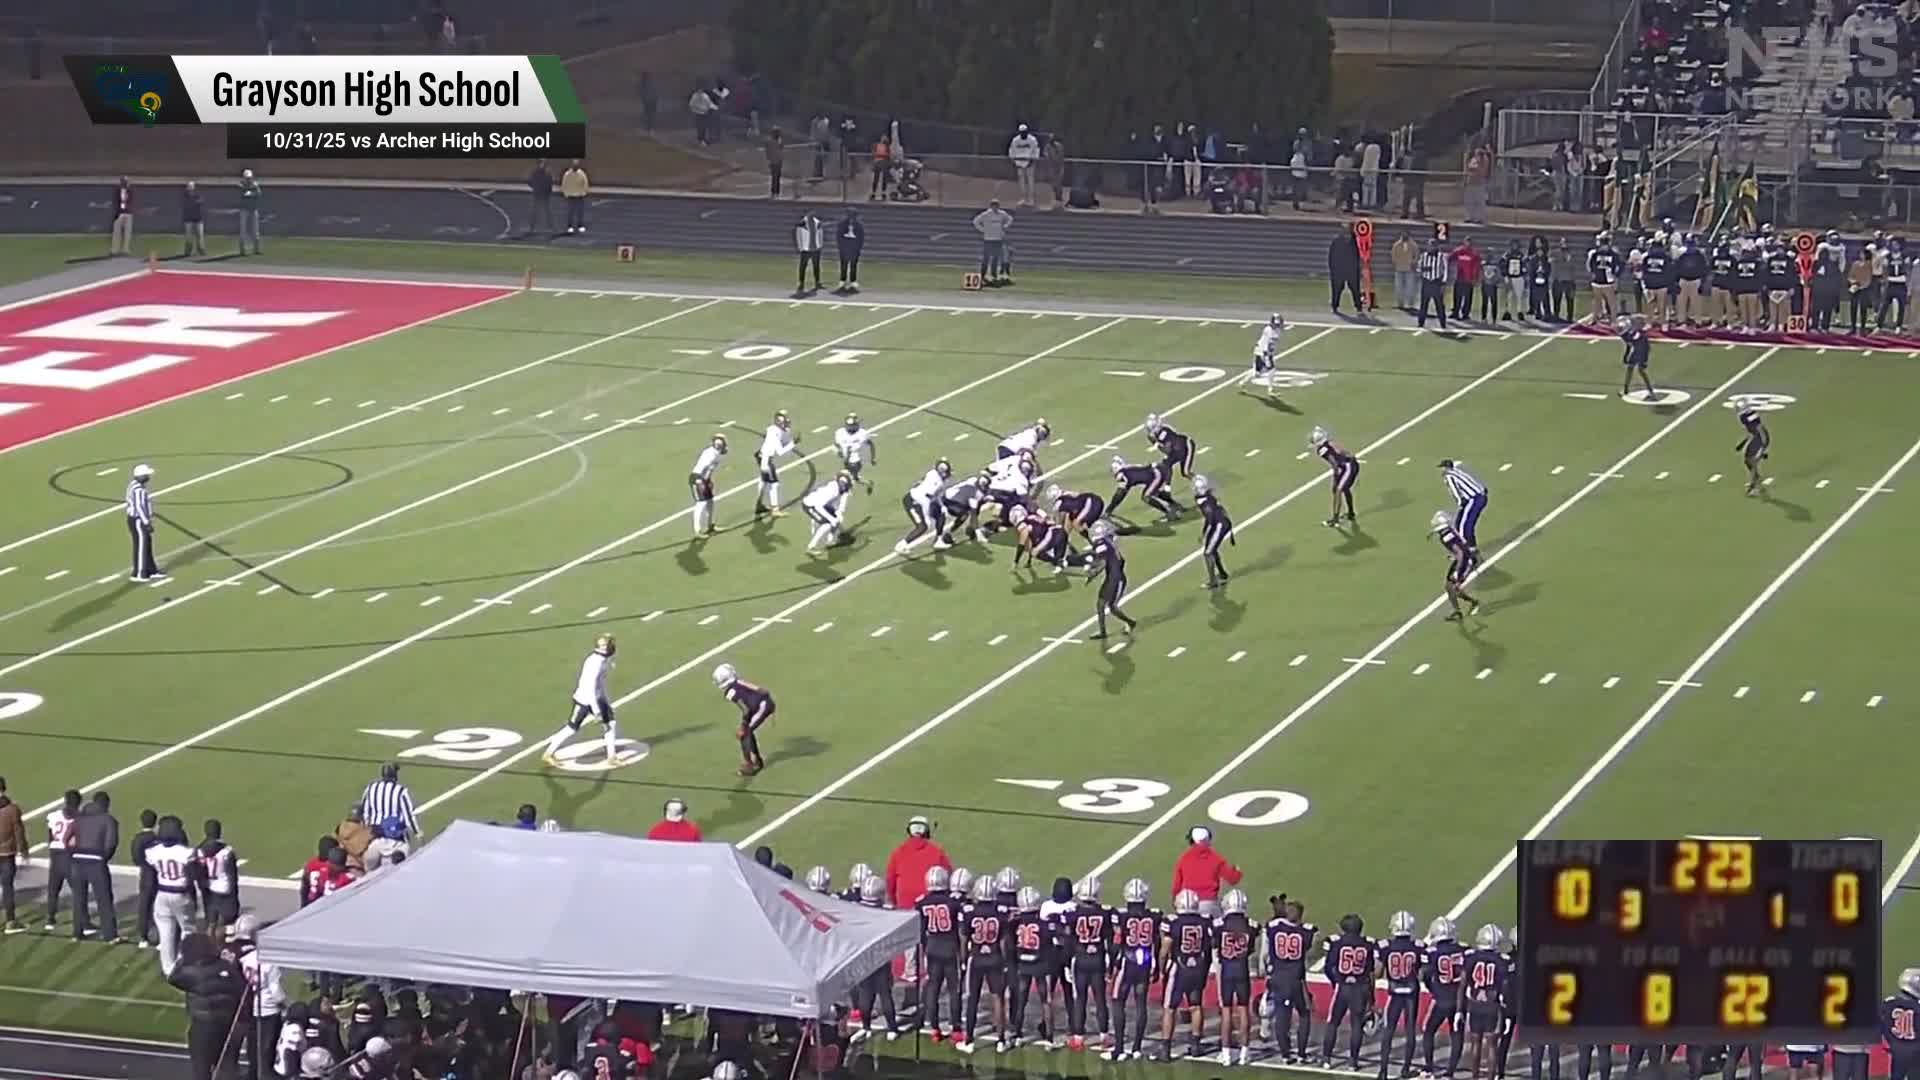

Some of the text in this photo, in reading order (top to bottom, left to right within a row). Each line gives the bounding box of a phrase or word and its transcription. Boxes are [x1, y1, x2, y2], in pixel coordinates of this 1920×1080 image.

[1437, 224, 1447, 240] 2
[965, 274, 980, 288] 10
[1789, 317, 1805, 331] 30
[156, 858, 184, 880] 10
[1555, 869, 1860, 922] 10 0
[1620, 889, 1643, 929] 3
[1772, 893, 1785, 929] 1
[922, 903, 952, 933] 78
[1075, 915, 1104, 943] 47
[1126, 917, 1153, 947] 39
[1180, 925, 1204, 954] 51
[1274, 931, 1304, 961] 89
[1338, 945, 1368, 975] 69
[1387, 951, 1417, 980] 80
[1471, 961, 1497, 989] 41
[1548, 972, 1849, 1024] 2 8 22 2
[1891, 1007, 1915, 1040] 31
